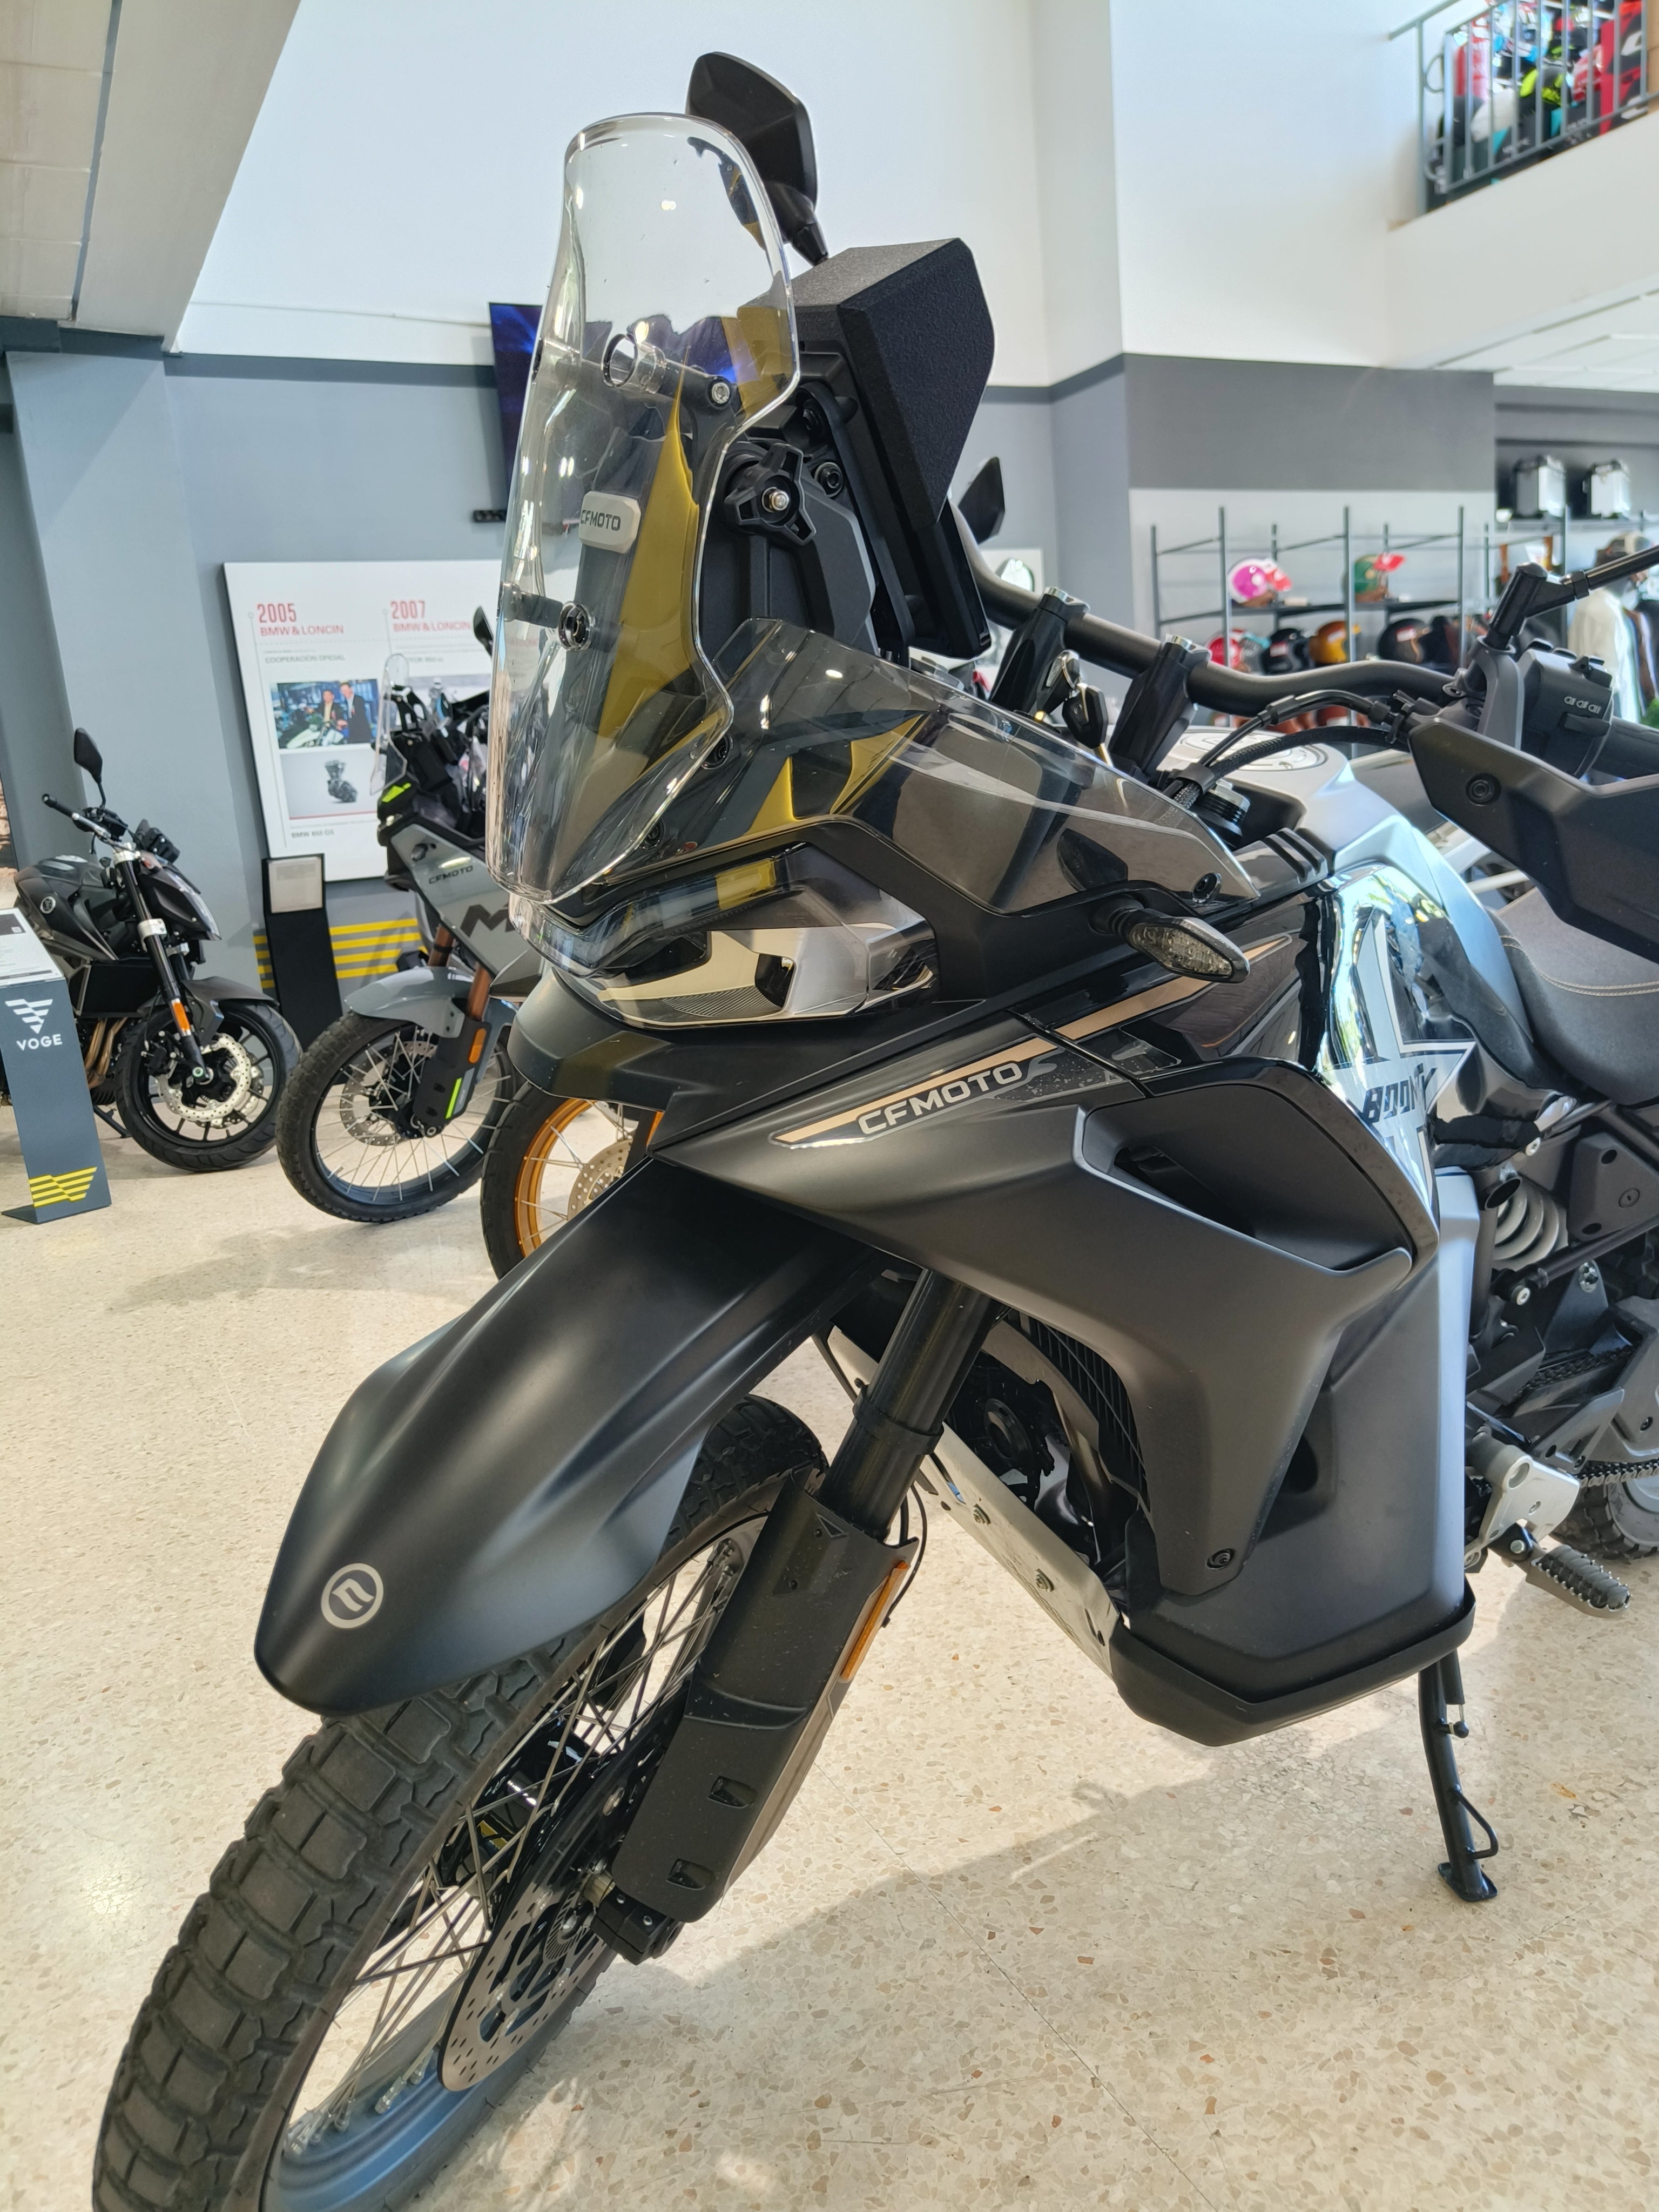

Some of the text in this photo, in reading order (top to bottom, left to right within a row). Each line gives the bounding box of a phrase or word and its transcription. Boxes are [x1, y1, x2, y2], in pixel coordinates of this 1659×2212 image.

[581, 509, 621, 531] CFMOTO
[257, 603, 296, 623] 2005
[390, 599, 426, 619] 2007
[260, 624, 345, 636] BMW & LONCIN
[393, 623, 420, 632] BMW
[422, 622, 430, 631] &
[429, 865, 473, 885] CFMOTO
[16, 1034, 63, 1051] VOGE
[858, 1062, 1023, 1135] CFMOTO
